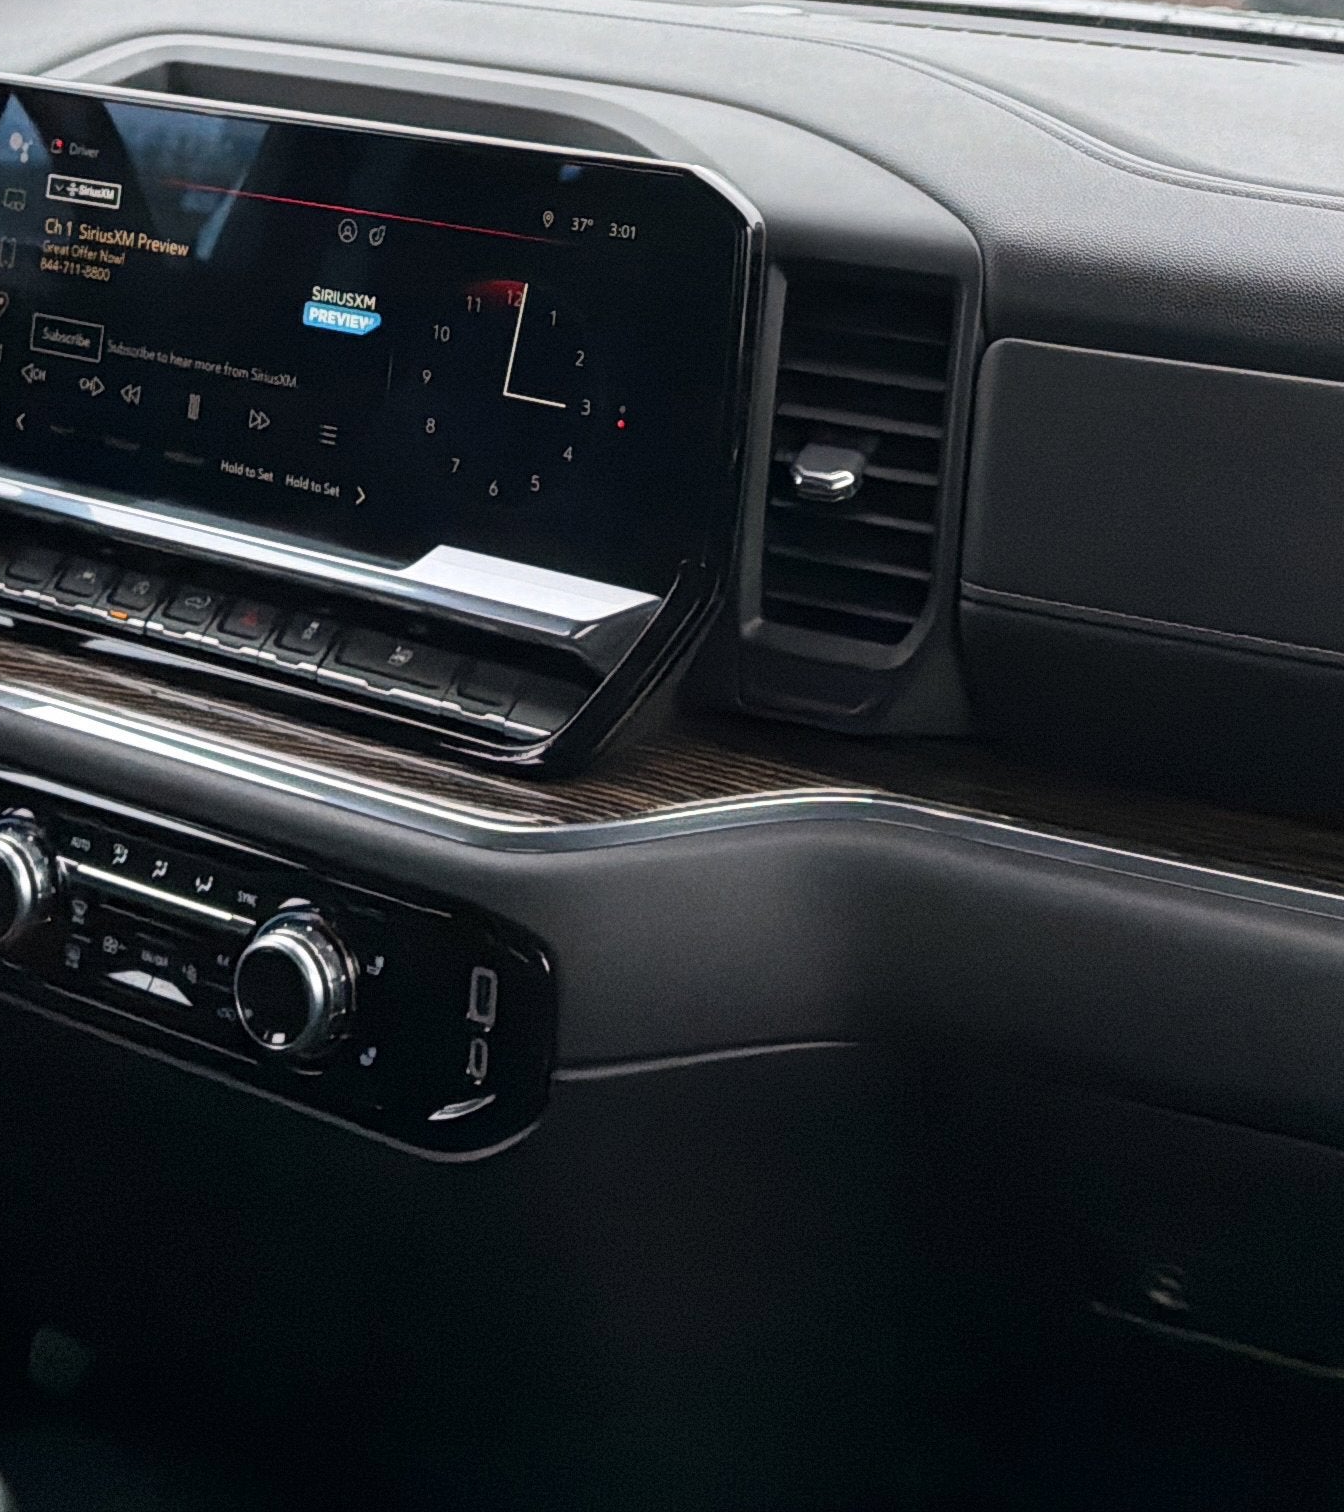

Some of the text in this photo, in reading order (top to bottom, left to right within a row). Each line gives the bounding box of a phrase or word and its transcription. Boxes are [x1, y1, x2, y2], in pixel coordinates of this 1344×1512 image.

[69, 142, 100, 158] Driver
[78, 184, 115, 200] SiriusXM
[45, 218, 189, 256] Ch 1 SiriusXM Preview
[609, 223, 637, 240] 3:01
[42, 240, 126, 266] Great Offer Now!
[312, 285, 376, 310] SIRIUSXM
[466, 295, 482, 313] 11
[506, 289, 523, 308] 12
[308, 305, 376, 329] PREVIEW
[549, 310, 558, 327] 1
[42, 326, 91, 349] Subscribe
[432, 324, 451, 343] 10
[107, 339, 297, 389] Subscribe to hear more from SiriusXM
[575, 351, 586, 368] 2
[422, 369, 432, 385] 9
[580, 399, 591, 416] 3
[425, 418, 436, 434] 8
[563, 446, 574, 462] 4
[220, 459, 274, 482] Hold to Set
[450, 458, 461, 474] 7
[285, 474, 340, 498] Hold to Set
[489, 480, 499, 497] 6
[530, 475, 541, 492] 5
[70, 836, 91, 852] AUTO
